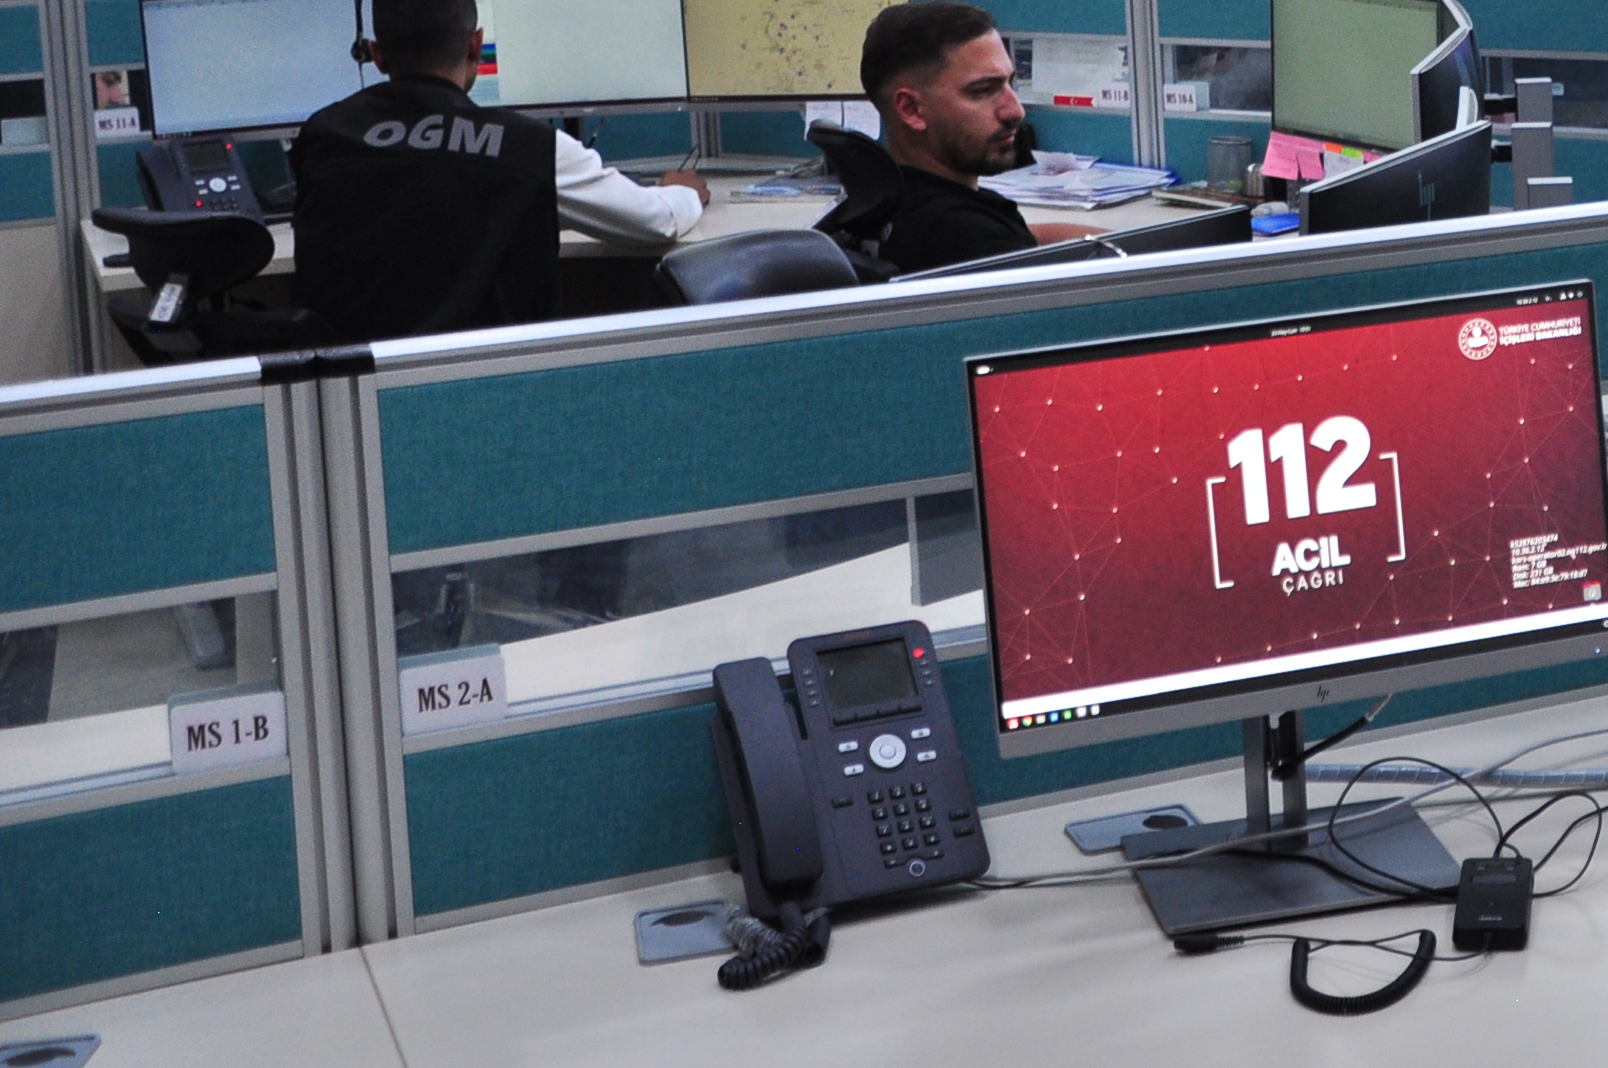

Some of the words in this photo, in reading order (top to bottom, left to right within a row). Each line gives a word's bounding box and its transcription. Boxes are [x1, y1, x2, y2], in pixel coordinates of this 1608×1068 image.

[363, 114, 504, 158] OGM
[1228, 415, 1377, 525] 112
[1282, 569, 1344, 597] ÇAĞRI
[418, 684, 451, 713] MS
[458, 677, 493, 706] 2-A
[186, 722, 222, 752] MS
[232, 714, 270, 745] 1-B
